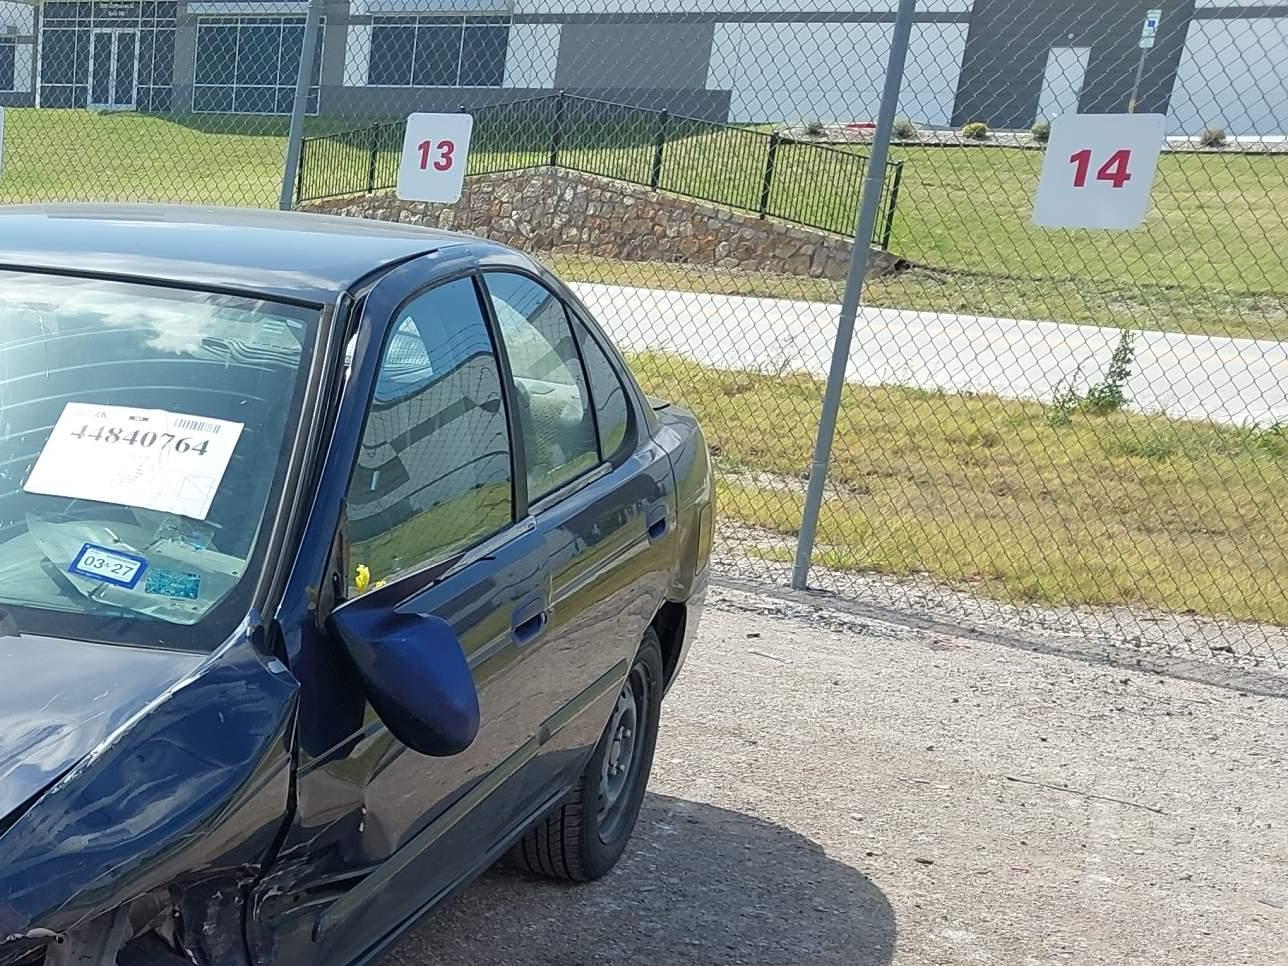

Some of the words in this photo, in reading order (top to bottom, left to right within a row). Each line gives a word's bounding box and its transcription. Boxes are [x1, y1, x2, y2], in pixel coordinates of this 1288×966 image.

[417, 140, 455, 171] 13
[1069, 149, 1132, 188] 14
[70, 423, 210, 456] 44840764
